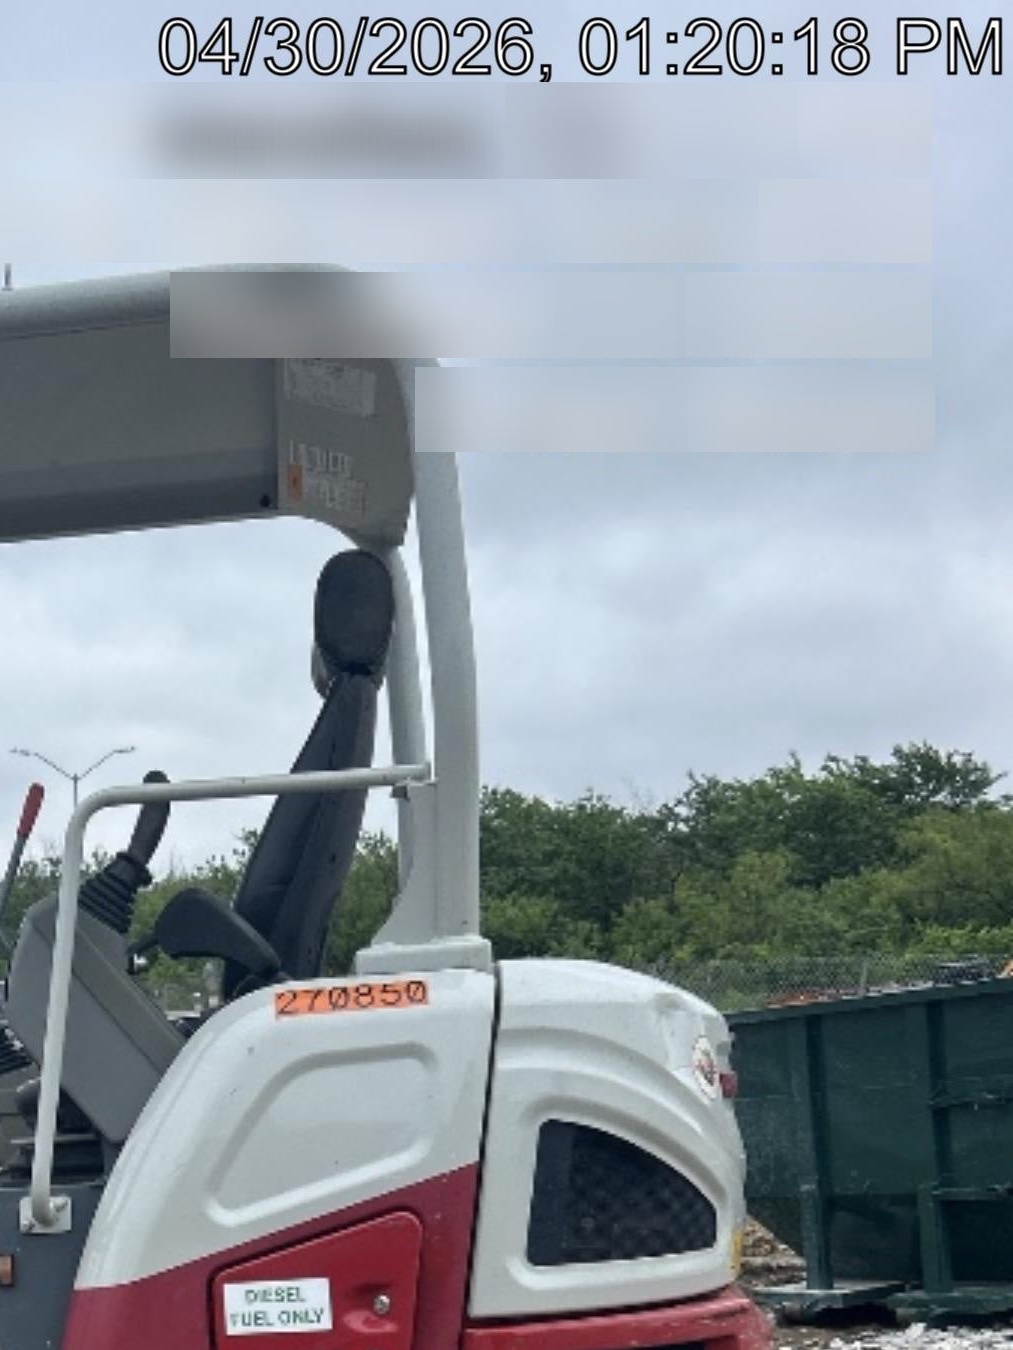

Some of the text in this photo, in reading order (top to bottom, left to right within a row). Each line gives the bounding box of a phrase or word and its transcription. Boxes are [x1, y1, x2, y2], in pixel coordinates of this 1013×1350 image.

[277, 980, 427, 1015] 270850
[244, 1286, 307, 1303] DIESEL
[230, 1307, 324, 1327] FUEL ONLY
